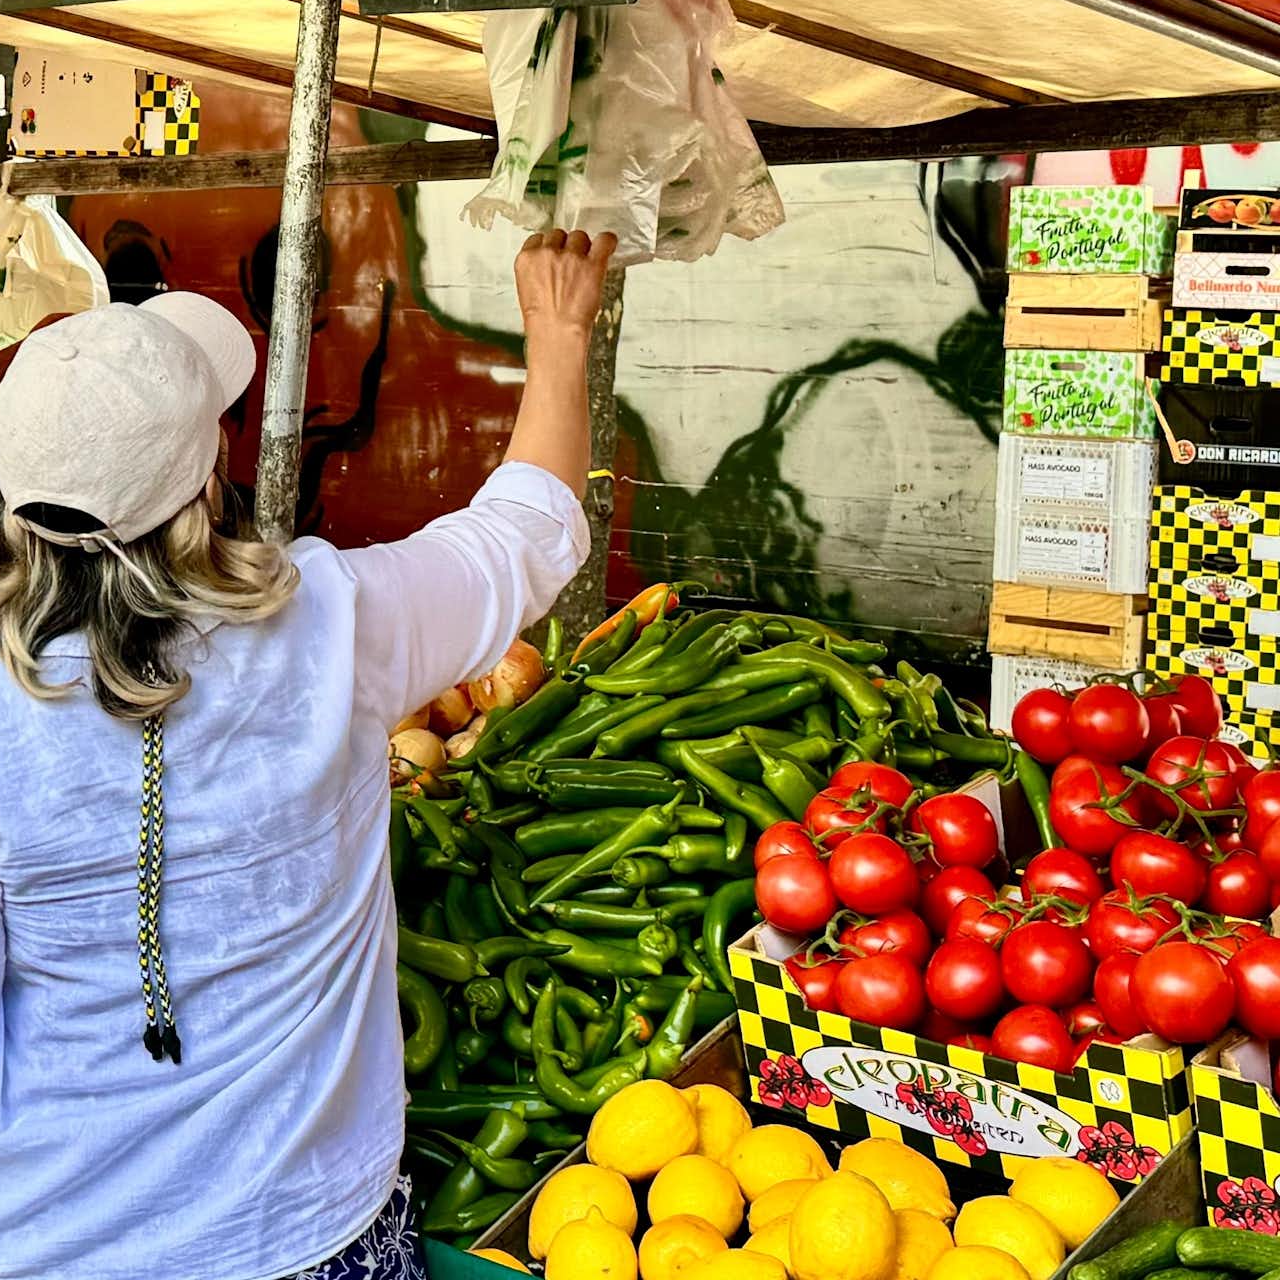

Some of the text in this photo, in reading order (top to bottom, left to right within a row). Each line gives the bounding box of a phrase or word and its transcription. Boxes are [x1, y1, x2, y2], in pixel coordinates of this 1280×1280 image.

[1047, 227, 1124, 261] Portugal
[1040, 392, 1116, 424] Portugal
[1197, 447, 1280, 464] DON RICARD
[1047, 464, 1080, 472] AVOCADO
[1044, 537, 1078, 546] AVOCADO
[823, 1051, 1072, 1153] cleopatra
